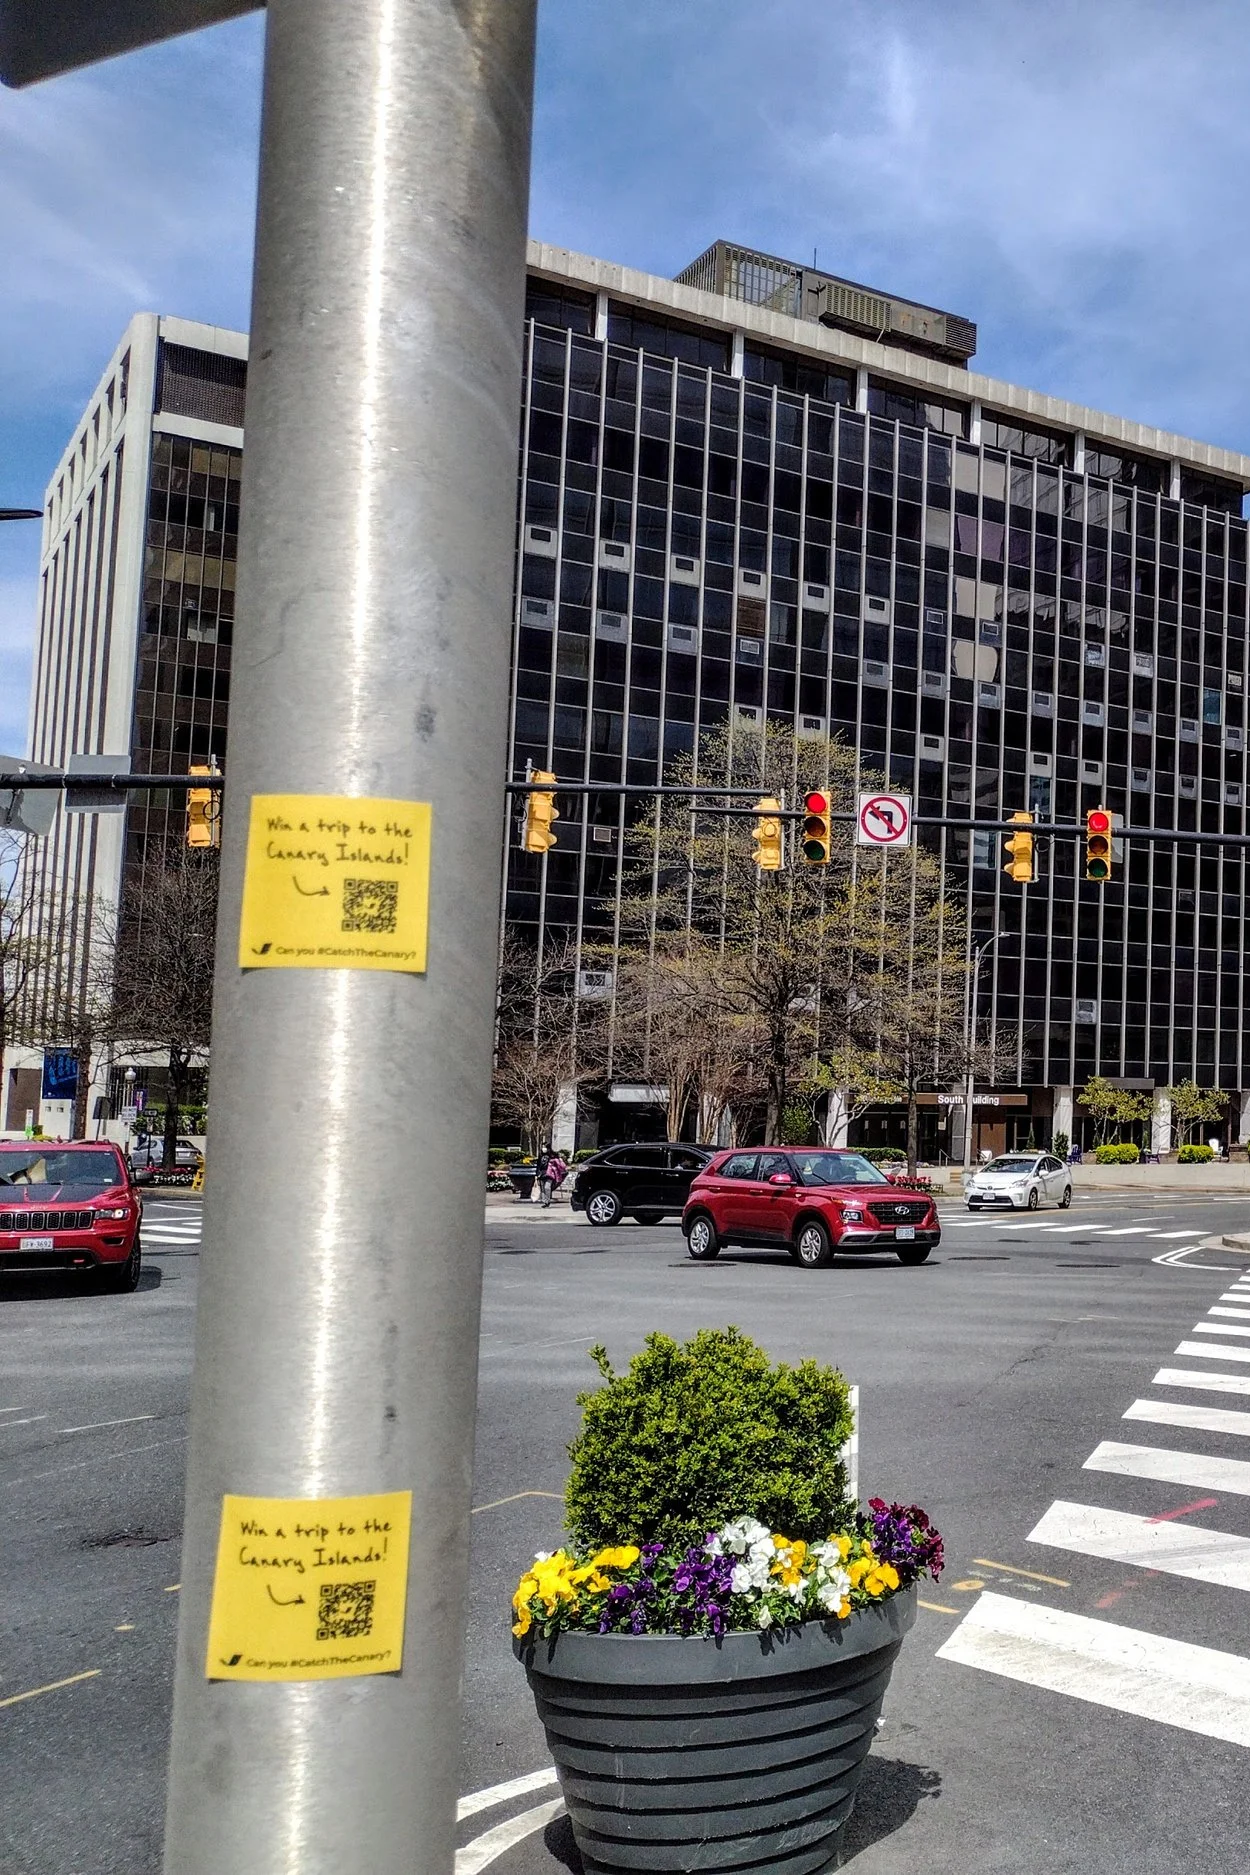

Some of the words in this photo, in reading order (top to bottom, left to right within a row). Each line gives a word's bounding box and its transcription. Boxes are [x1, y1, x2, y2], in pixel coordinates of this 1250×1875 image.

[267, 816, 293, 832] Win
[300, 820, 310, 832] a
[316, 819, 350, 838] trip
[358, 821, 376, 835] to
[384, 823, 413, 838] the
[266, 841, 329, 867] Canary
[336, 843, 409, 866] Islands!
[275, 946, 294, 955] Can
[296, 947, 315, 957] you
[317, 946, 417, 961] #CatchTheCanary?
[937, 1094, 964, 1104] South
[971, 1095, 1000, 1106] uilding
[240, 1520, 268, 1537] Win
[275, 1527, 286, 1538] a
[294, 1524, 329, 1542] trip
[337, 1522, 355, 1536] to
[364, 1518, 392, 1533] the
[239, 1547, 305, 1573] Canary
[313, 1537, 388, 1567] Islands!
[246, 1658, 265, 1668] Can
[268, 1660, 288, 1669] you
[290, 1650, 392, 1669] #CatchTheCanary?
